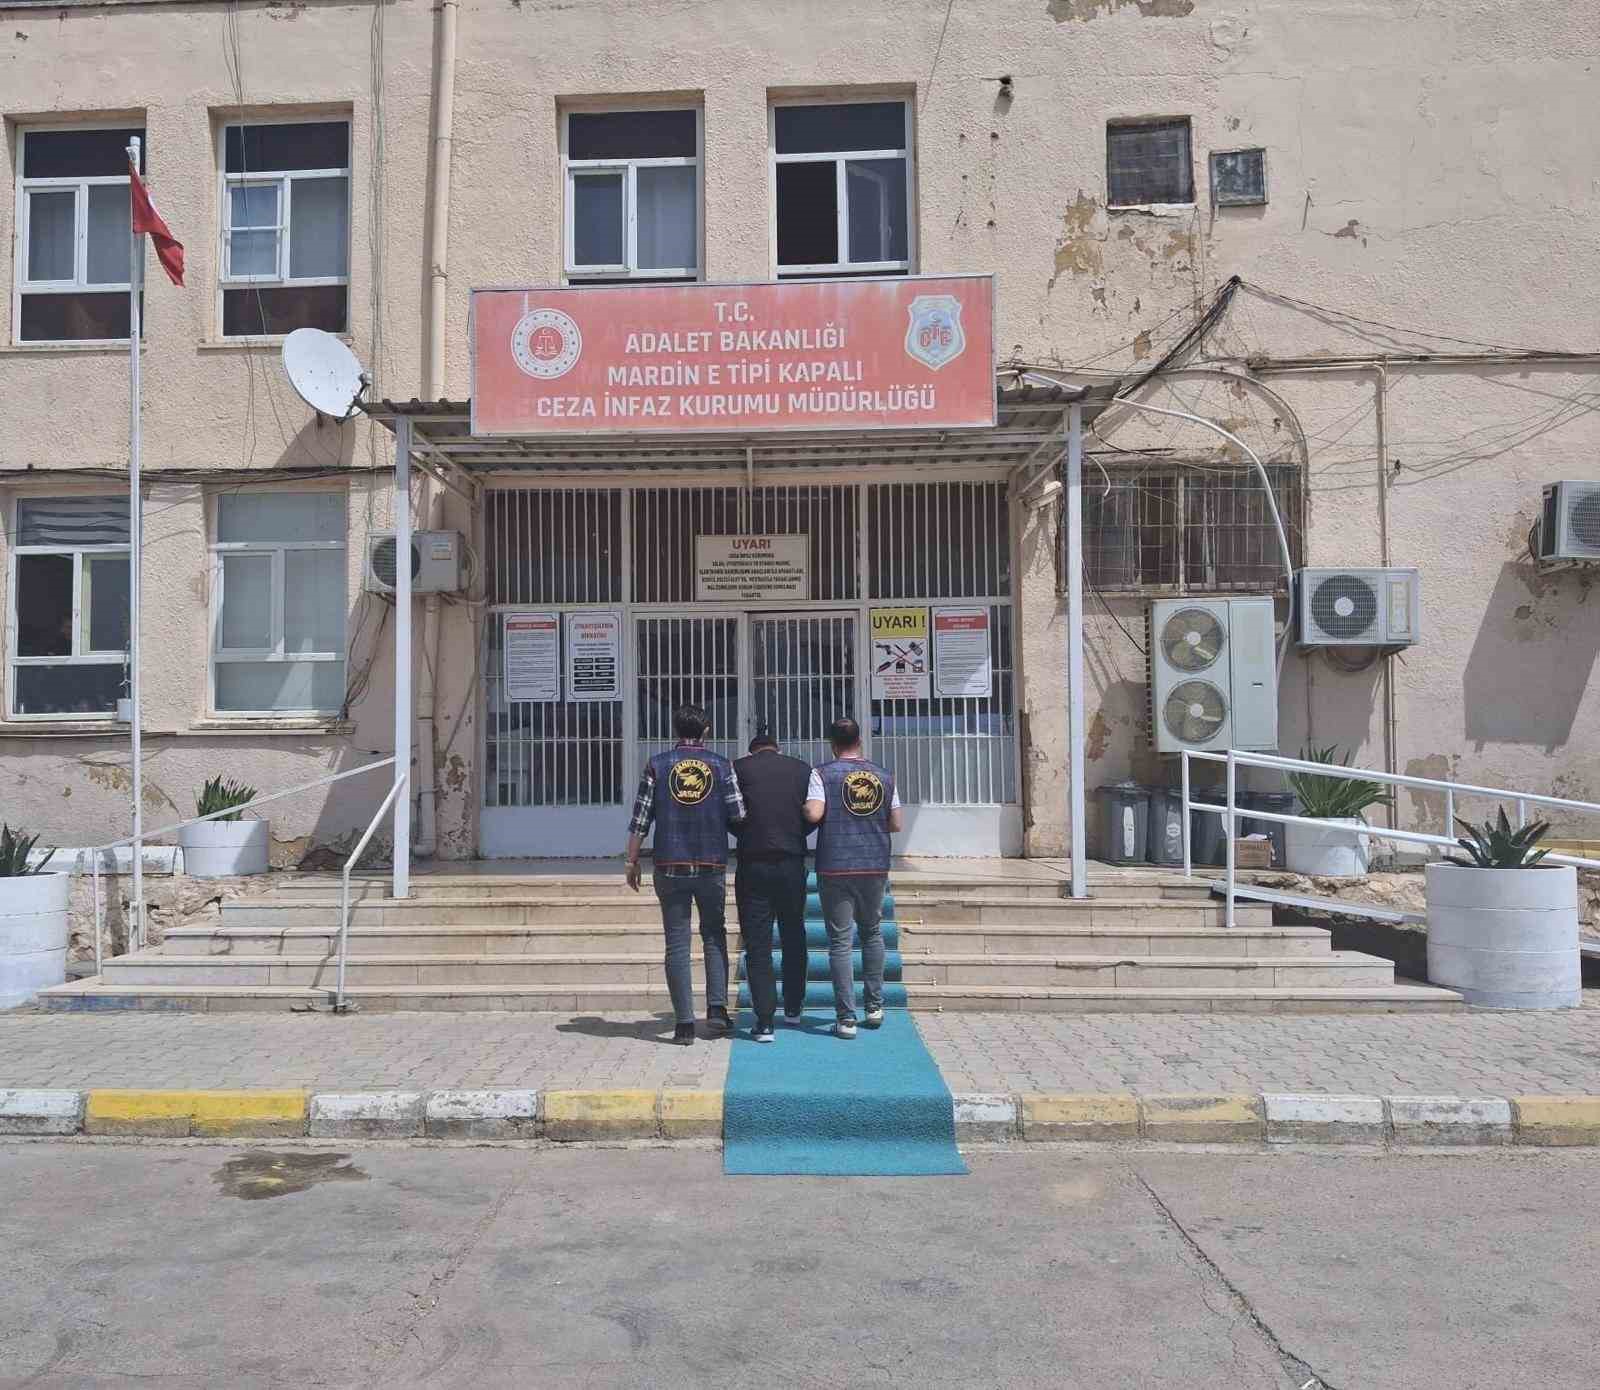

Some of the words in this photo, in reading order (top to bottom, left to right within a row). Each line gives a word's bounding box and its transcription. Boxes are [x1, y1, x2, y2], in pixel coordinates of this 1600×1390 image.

[713, 301, 754, 322] T.C.
[625, 331, 712, 353] ADALET
[719, 322, 846, 352] BAKANLIĞI
[608, 360, 700, 386] MARDİN
[707, 365, 720, 385] E
[727, 358, 771, 384] TİPİ
[778, 360, 864, 384] KAPALI
[536, 396, 596, 417] CEZA
[604, 391, 672, 417] İNFAZ
[679, 393, 780, 416] KURUMU
[788, 384, 936, 414] MÜDÜRLÜĞÜ
[732, 538, 771, 550] UYARI
[873, 615, 917, 629] UYARI
